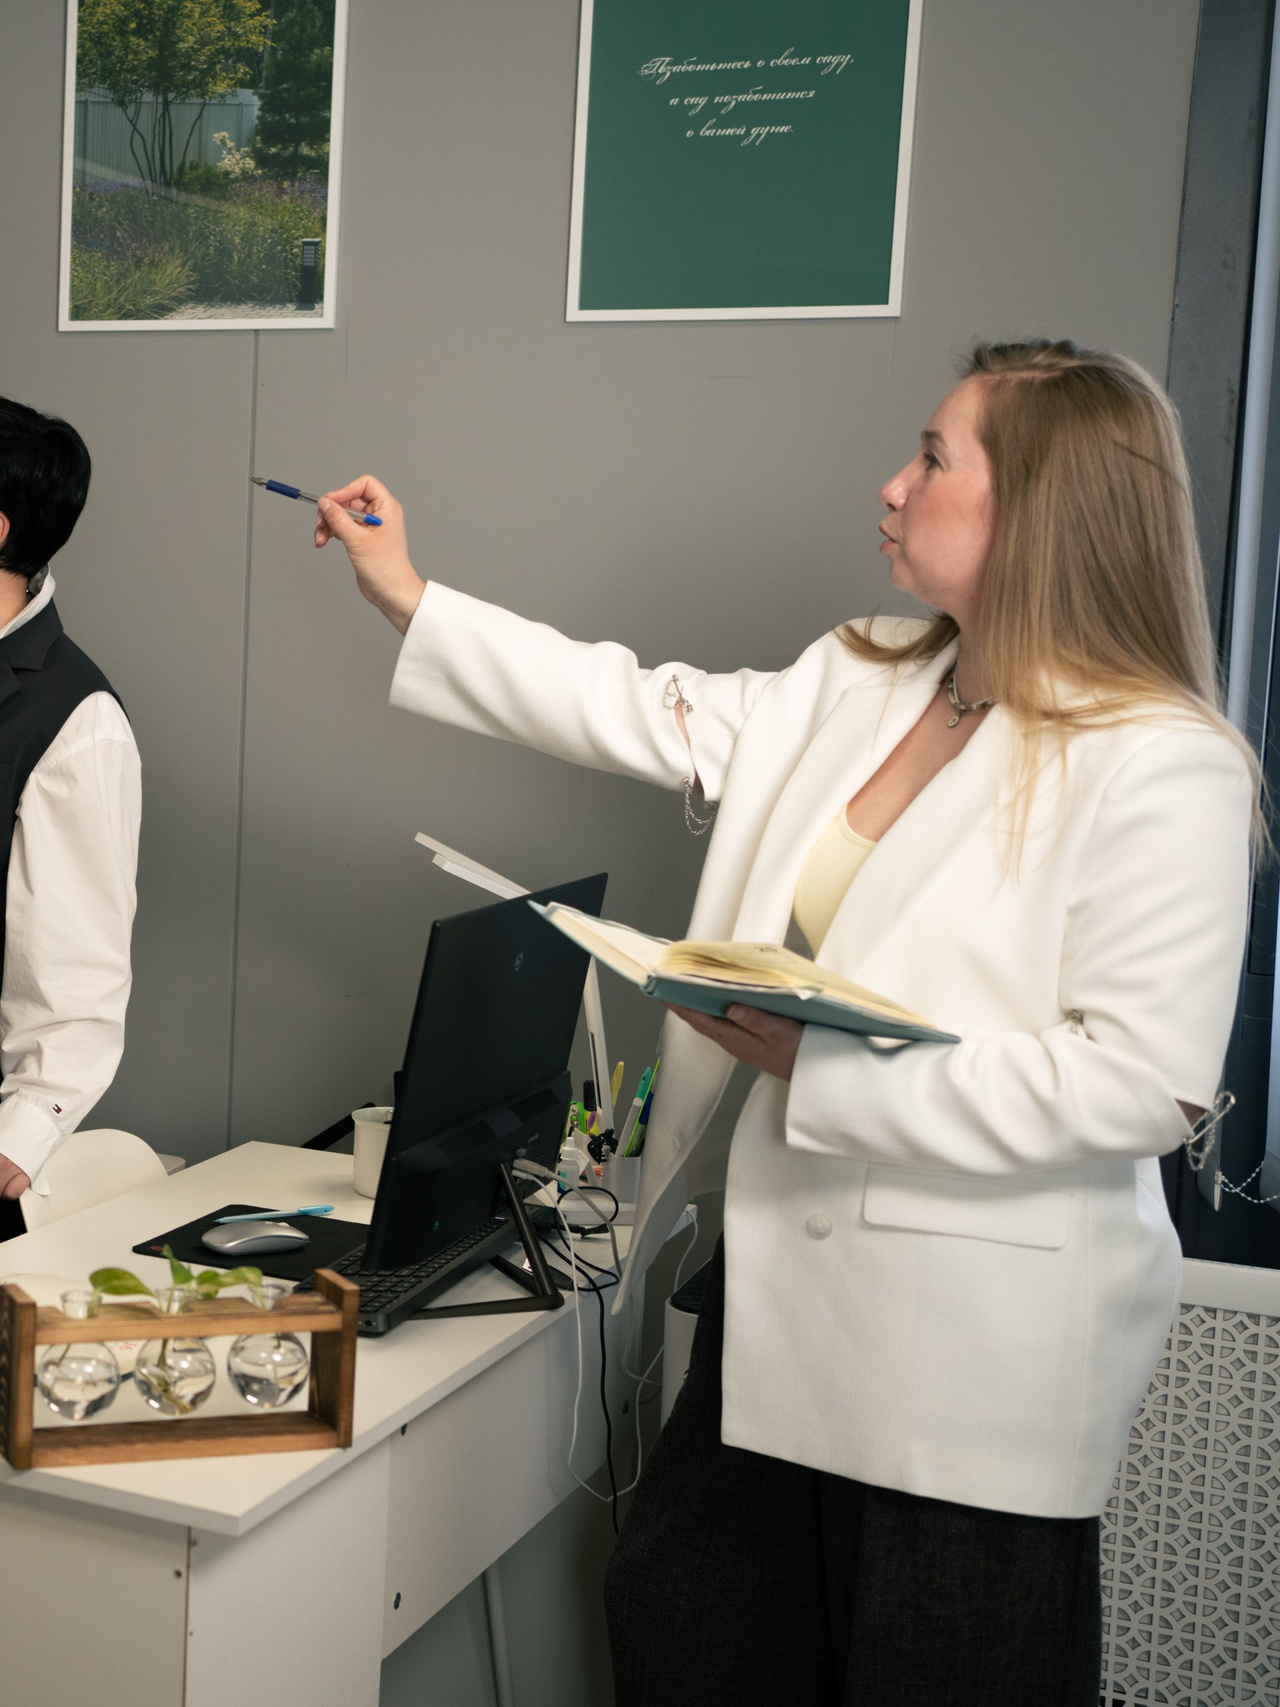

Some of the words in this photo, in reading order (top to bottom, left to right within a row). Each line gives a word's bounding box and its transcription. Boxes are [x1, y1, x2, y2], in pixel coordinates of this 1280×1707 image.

[638, 57, 751, 85] Позаботьтесь
[756, 60, 765, 68] о
[770, 47, 811, 67] своем
[816, 54, 854, 75] саду,
[669, 97, 679, 106] а
[684, 96, 709, 116] сад
[714, 86, 816, 114] позаботится
[686, 130, 694, 138] о
[699, 118, 746, 137] вашей
[741, 125, 793, 146] душе.
